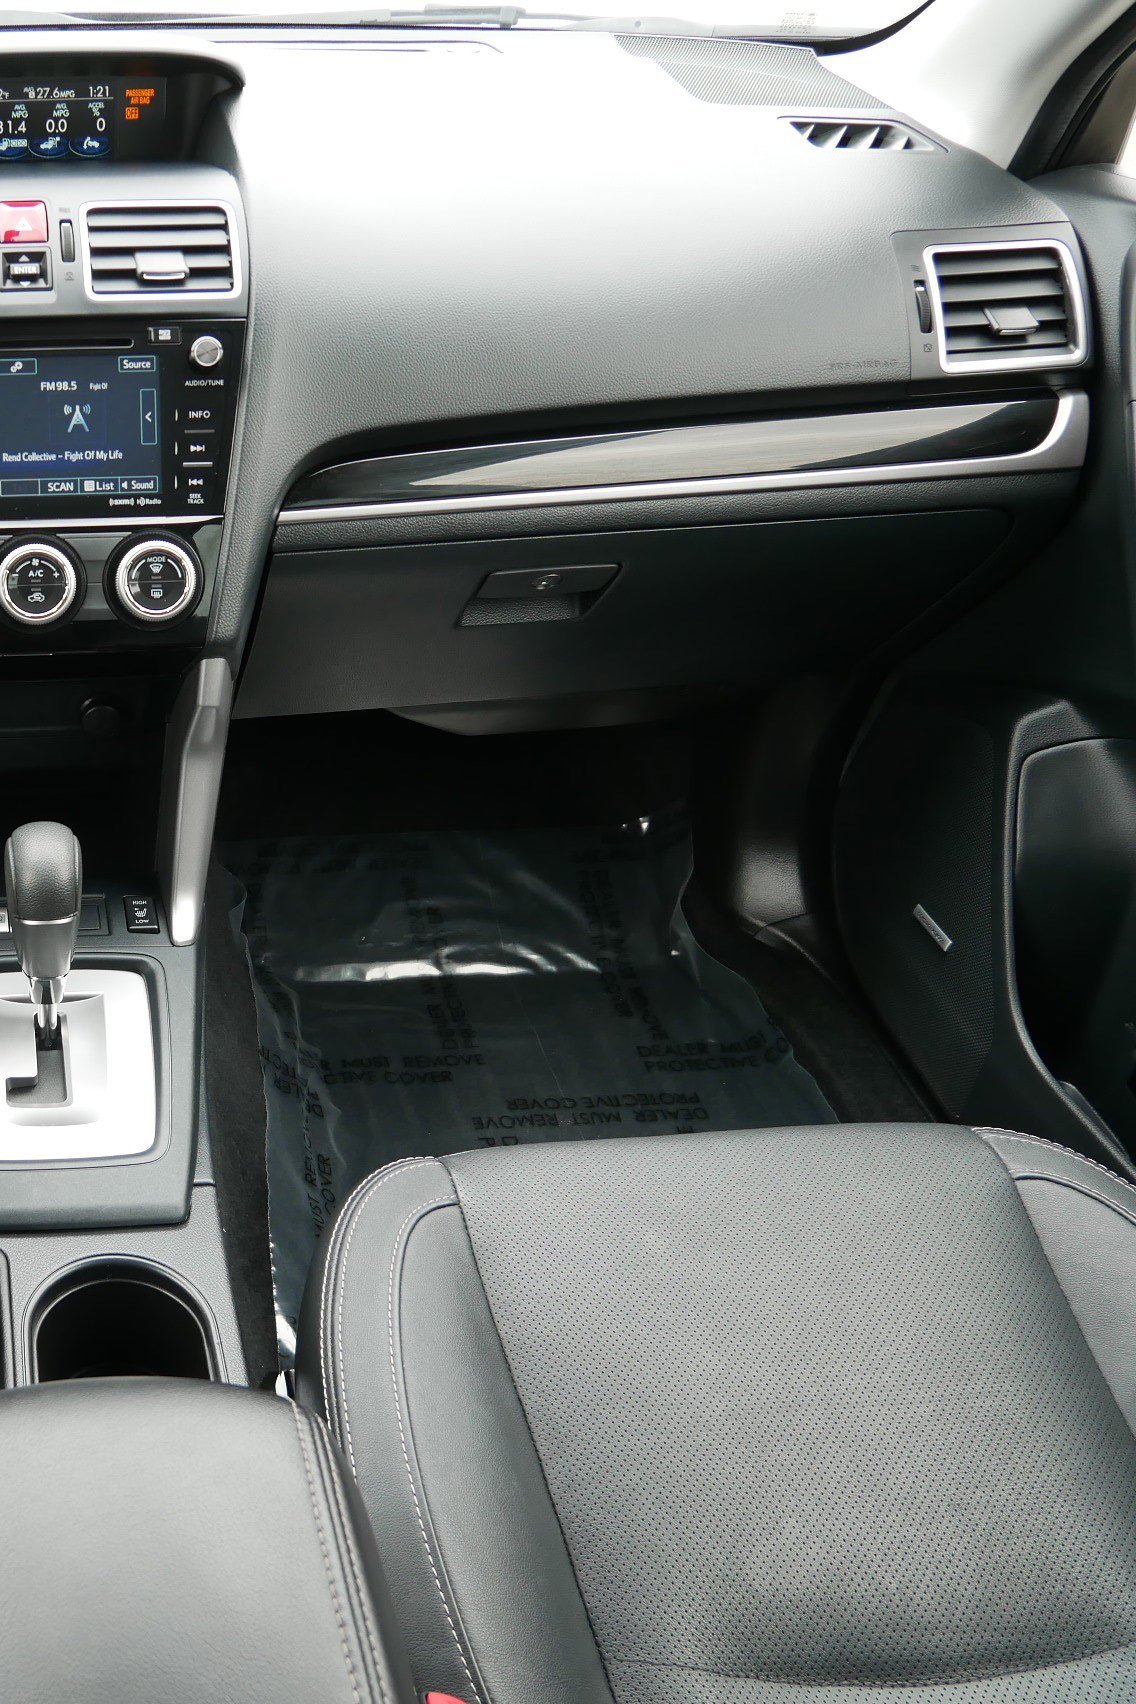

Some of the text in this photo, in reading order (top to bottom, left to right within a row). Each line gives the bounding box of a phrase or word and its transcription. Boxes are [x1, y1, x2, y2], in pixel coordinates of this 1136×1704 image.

[88, 85, 110, 98] 1:21
[125, 88, 155, 98] PASSENGER
[130, 97, 151, 105] AIR BAG
[11, 110, 29, 119] MPG
[52, 110, 70, 118] MPG
[125, 108, 139, 119] OFF
[45, 118, 68, 133] 0.0
[96, 117, 106, 132] 0
[13, 266, 37, 274] ENTER
[122, 359, 151, 369] Source
[184, 379, 225, 387] AUDIO/TUNE
[188, 410, 211, 419] INFO
[2, 452, 21, 463] Rend
[22, 451, 57, 462] Collective
[64, 450, 84, 463] Fight
[84, 450, 96, 460] Of
[95, 450, 108, 462] My
[108, 449, 123, 460] Life
[47, 482, 74, 492] SCAN
[96, 481, 115, 491] List
[131, 480, 154, 490] Sound
[27, 568, 44, 578] A/C
[636, 1040, 709, 1058] DEALER
[720, 1030, 767, 1053] MUST
[342, 1056, 390, 1069] MUST
[403, 1054, 485, 1069] REMOVE
[643, 1056, 761, 1073] PROTECTIVE
[384, 1070, 454, 1084] COVER
[507, 1091, 701, 1111] PROTECTIVE COVER
[472, 1106, 710, 1131] DEALER MUST REMOVE
